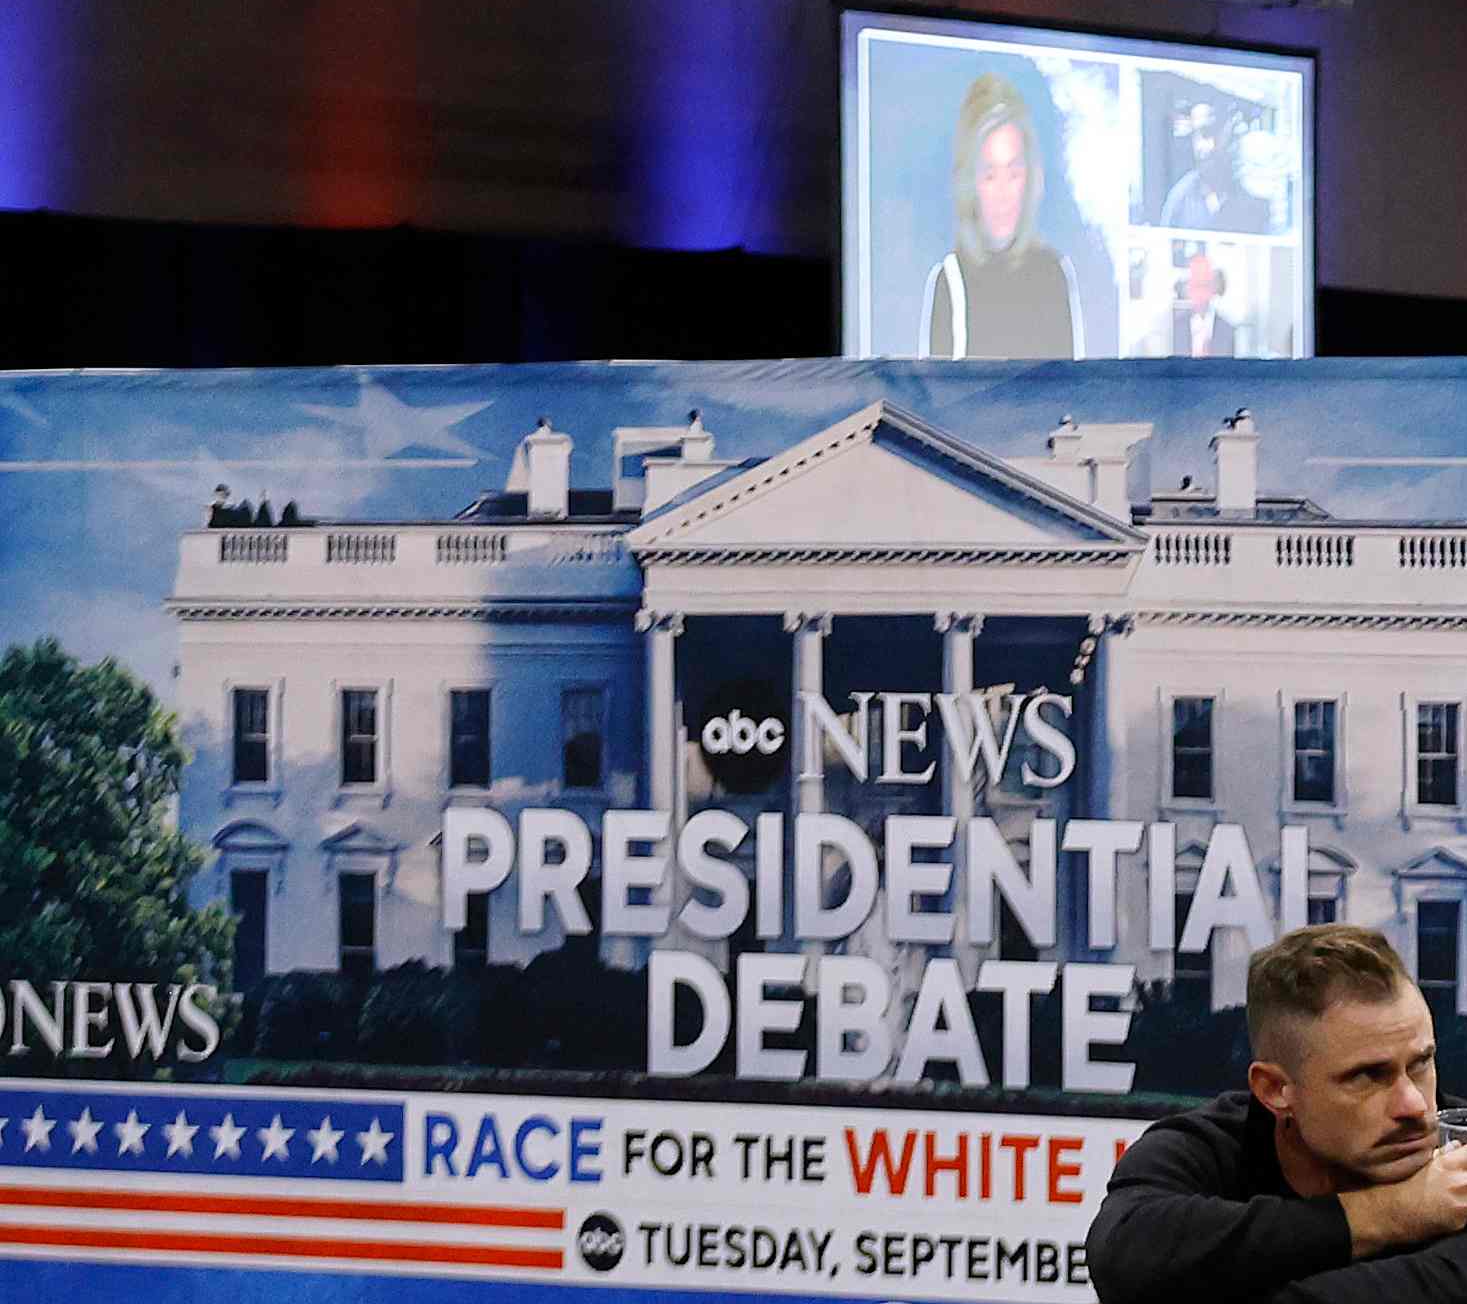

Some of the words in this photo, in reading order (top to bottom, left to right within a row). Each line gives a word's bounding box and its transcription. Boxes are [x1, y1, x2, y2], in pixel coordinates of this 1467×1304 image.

[702, 708, 786, 756] abc
[797, 690, 1078, 789] NEWS
[10, 979, 222, 1064] NEWS
[648, 949, 1138, 1093] DEBATE
[423, 1113, 606, 1183] RACE
[623, 1129, 716, 1181] FOR
[734, 1134, 828, 1182] THE
[843, 1125, 1086, 1203] WHITE
[638, 1222, 840, 1278] TUESDAY,
[854, 1232, 1091, 1285] SEPTEMBE
